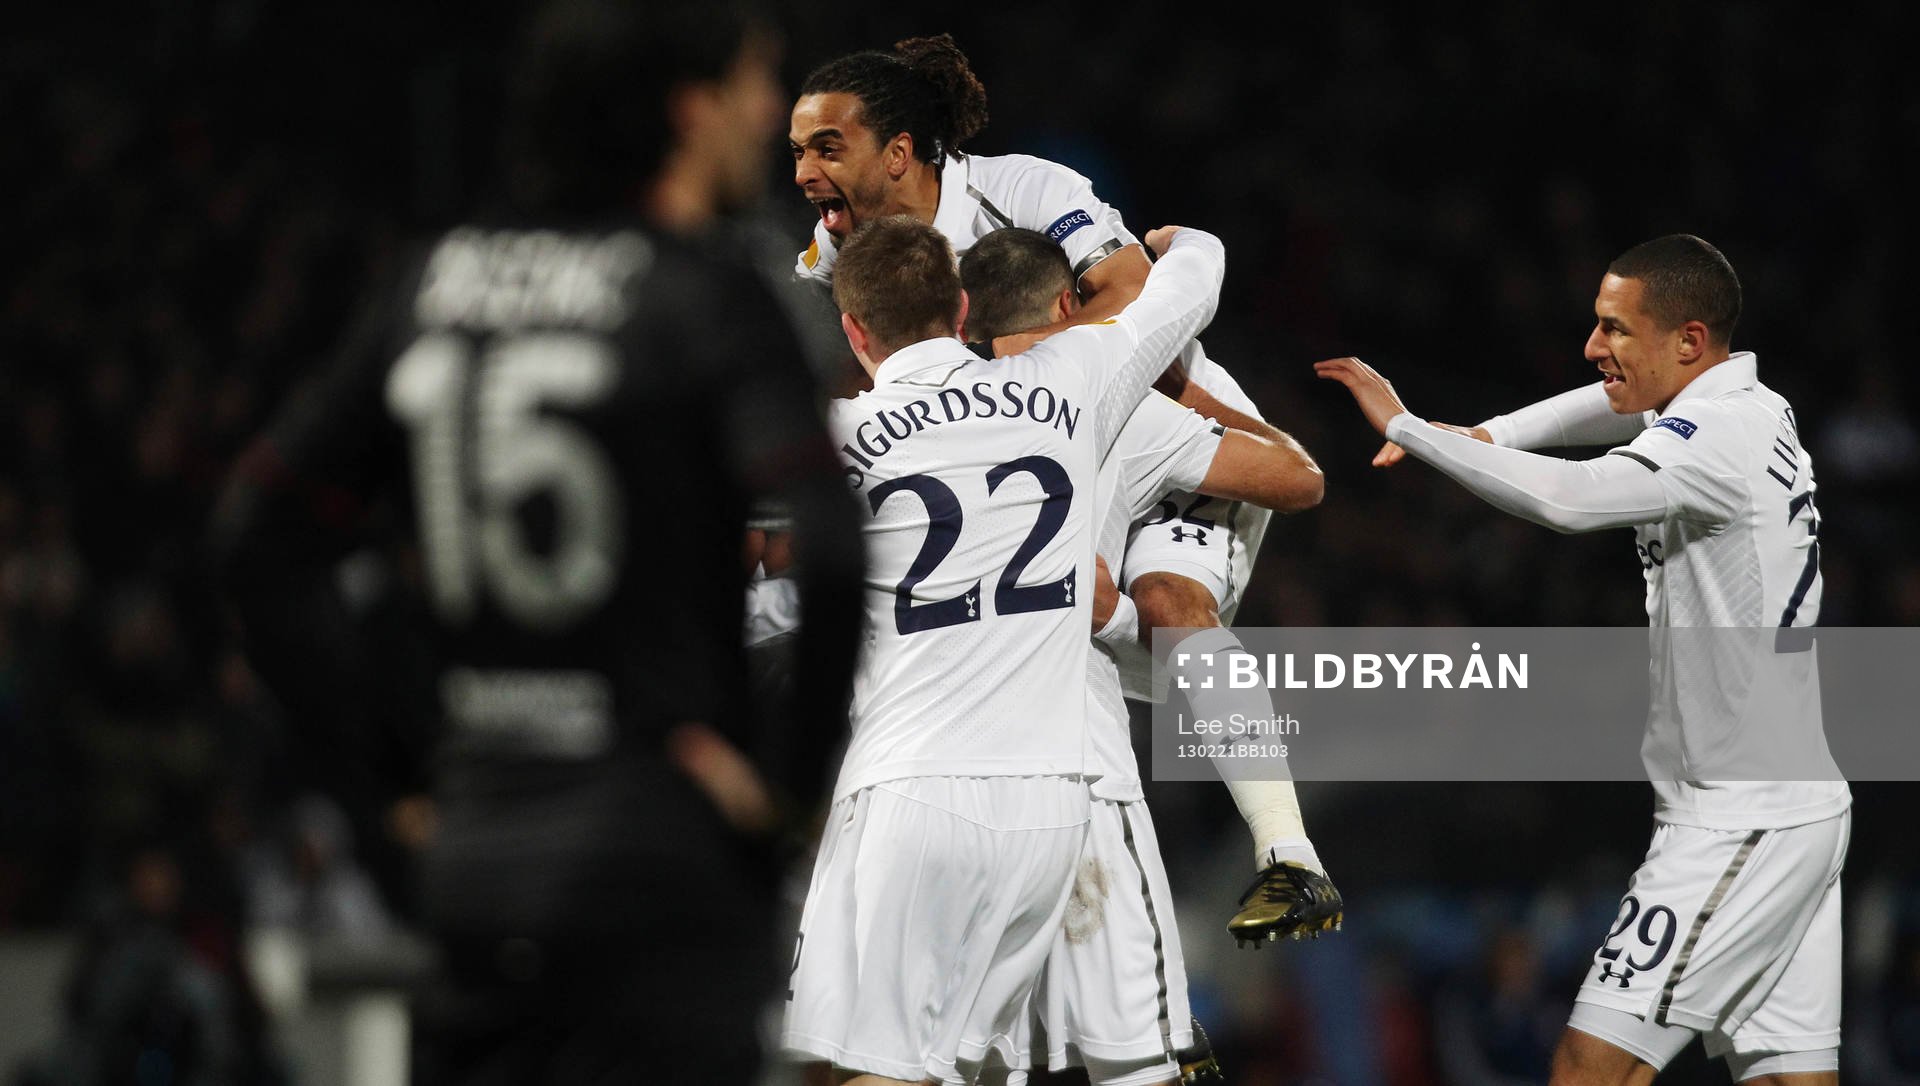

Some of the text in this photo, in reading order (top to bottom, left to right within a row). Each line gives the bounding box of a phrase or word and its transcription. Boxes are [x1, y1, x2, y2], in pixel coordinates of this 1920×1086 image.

[1050, 213, 1090, 239] RESPECT
[841, 381, 1081, 490] SIGURDSSON
[867, 455, 1077, 636] 22
[1598, 895, 1677, 971] 29
